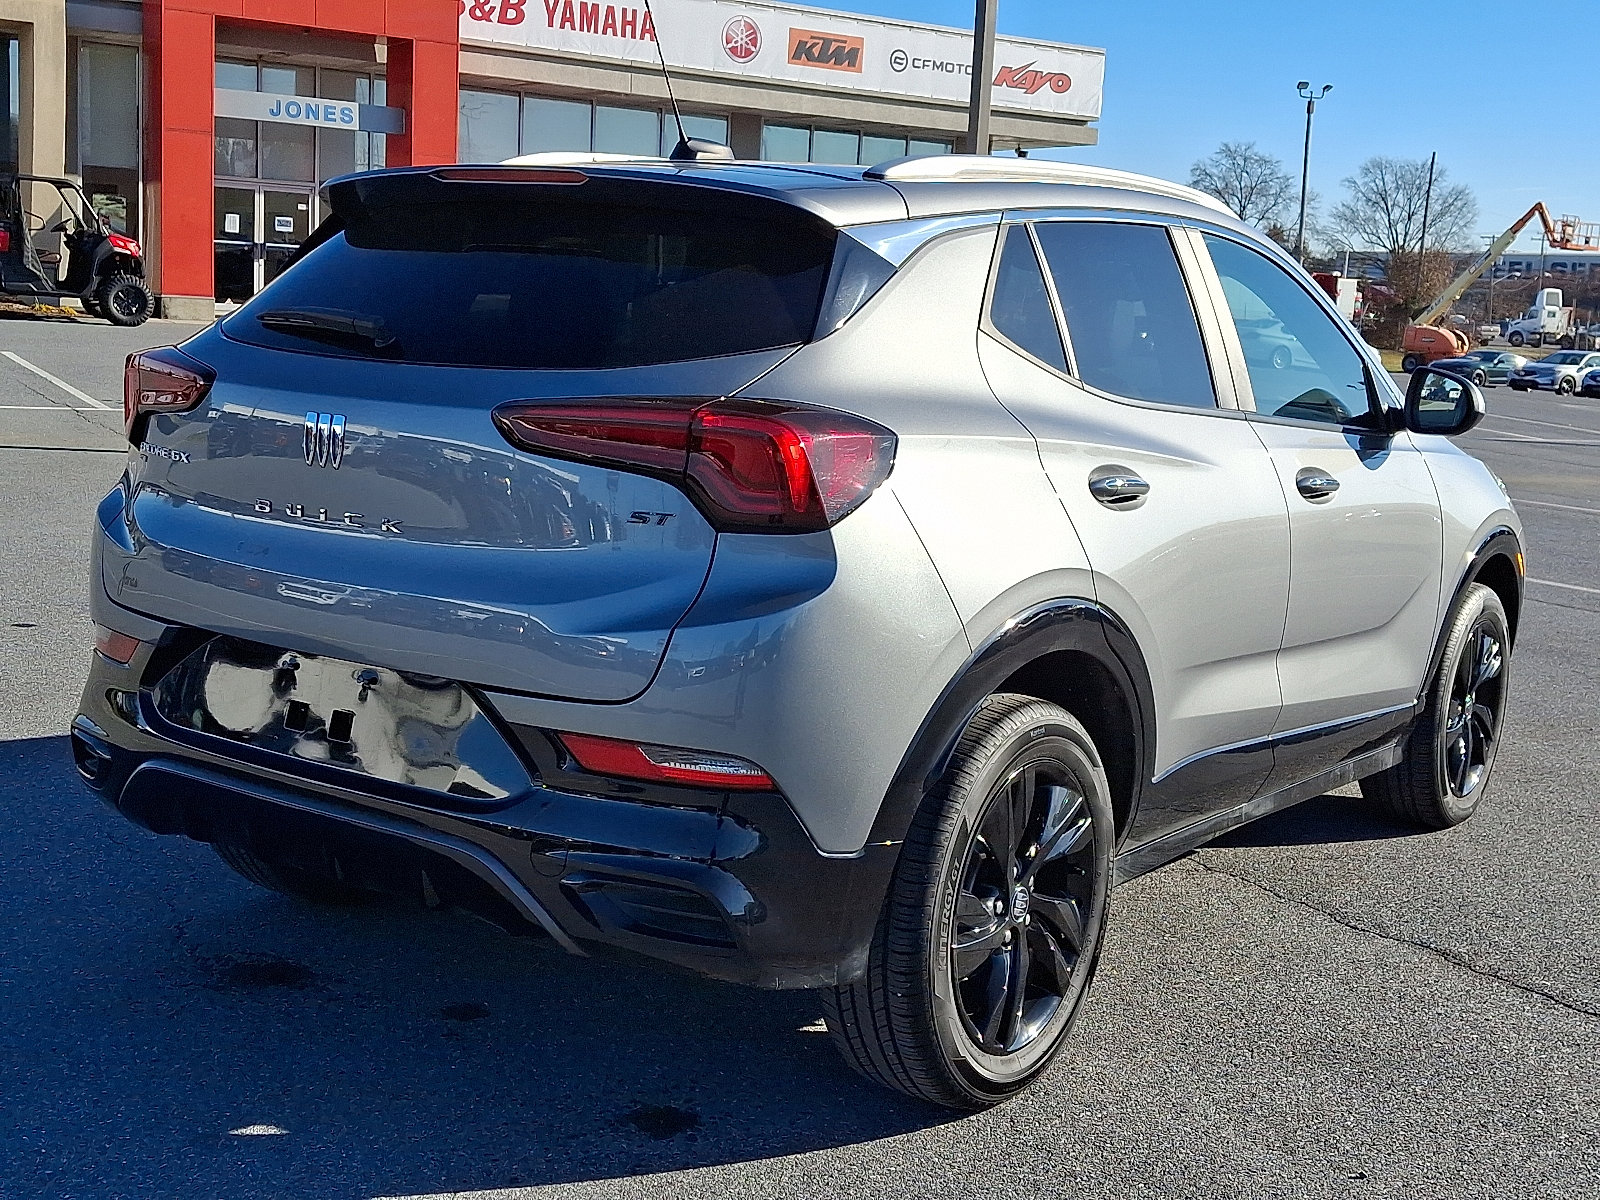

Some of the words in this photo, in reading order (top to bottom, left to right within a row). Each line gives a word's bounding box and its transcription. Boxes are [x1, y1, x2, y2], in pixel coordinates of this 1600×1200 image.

[458, 0, 526, 25] &B
[544, 0, 656, 42] YAMAHA
[791, 35, 860, 68] KTM
[268, 99, 354, 125] JONES
[171, 450, 192, 464] GX
[624, 510, 677, 527] ST
